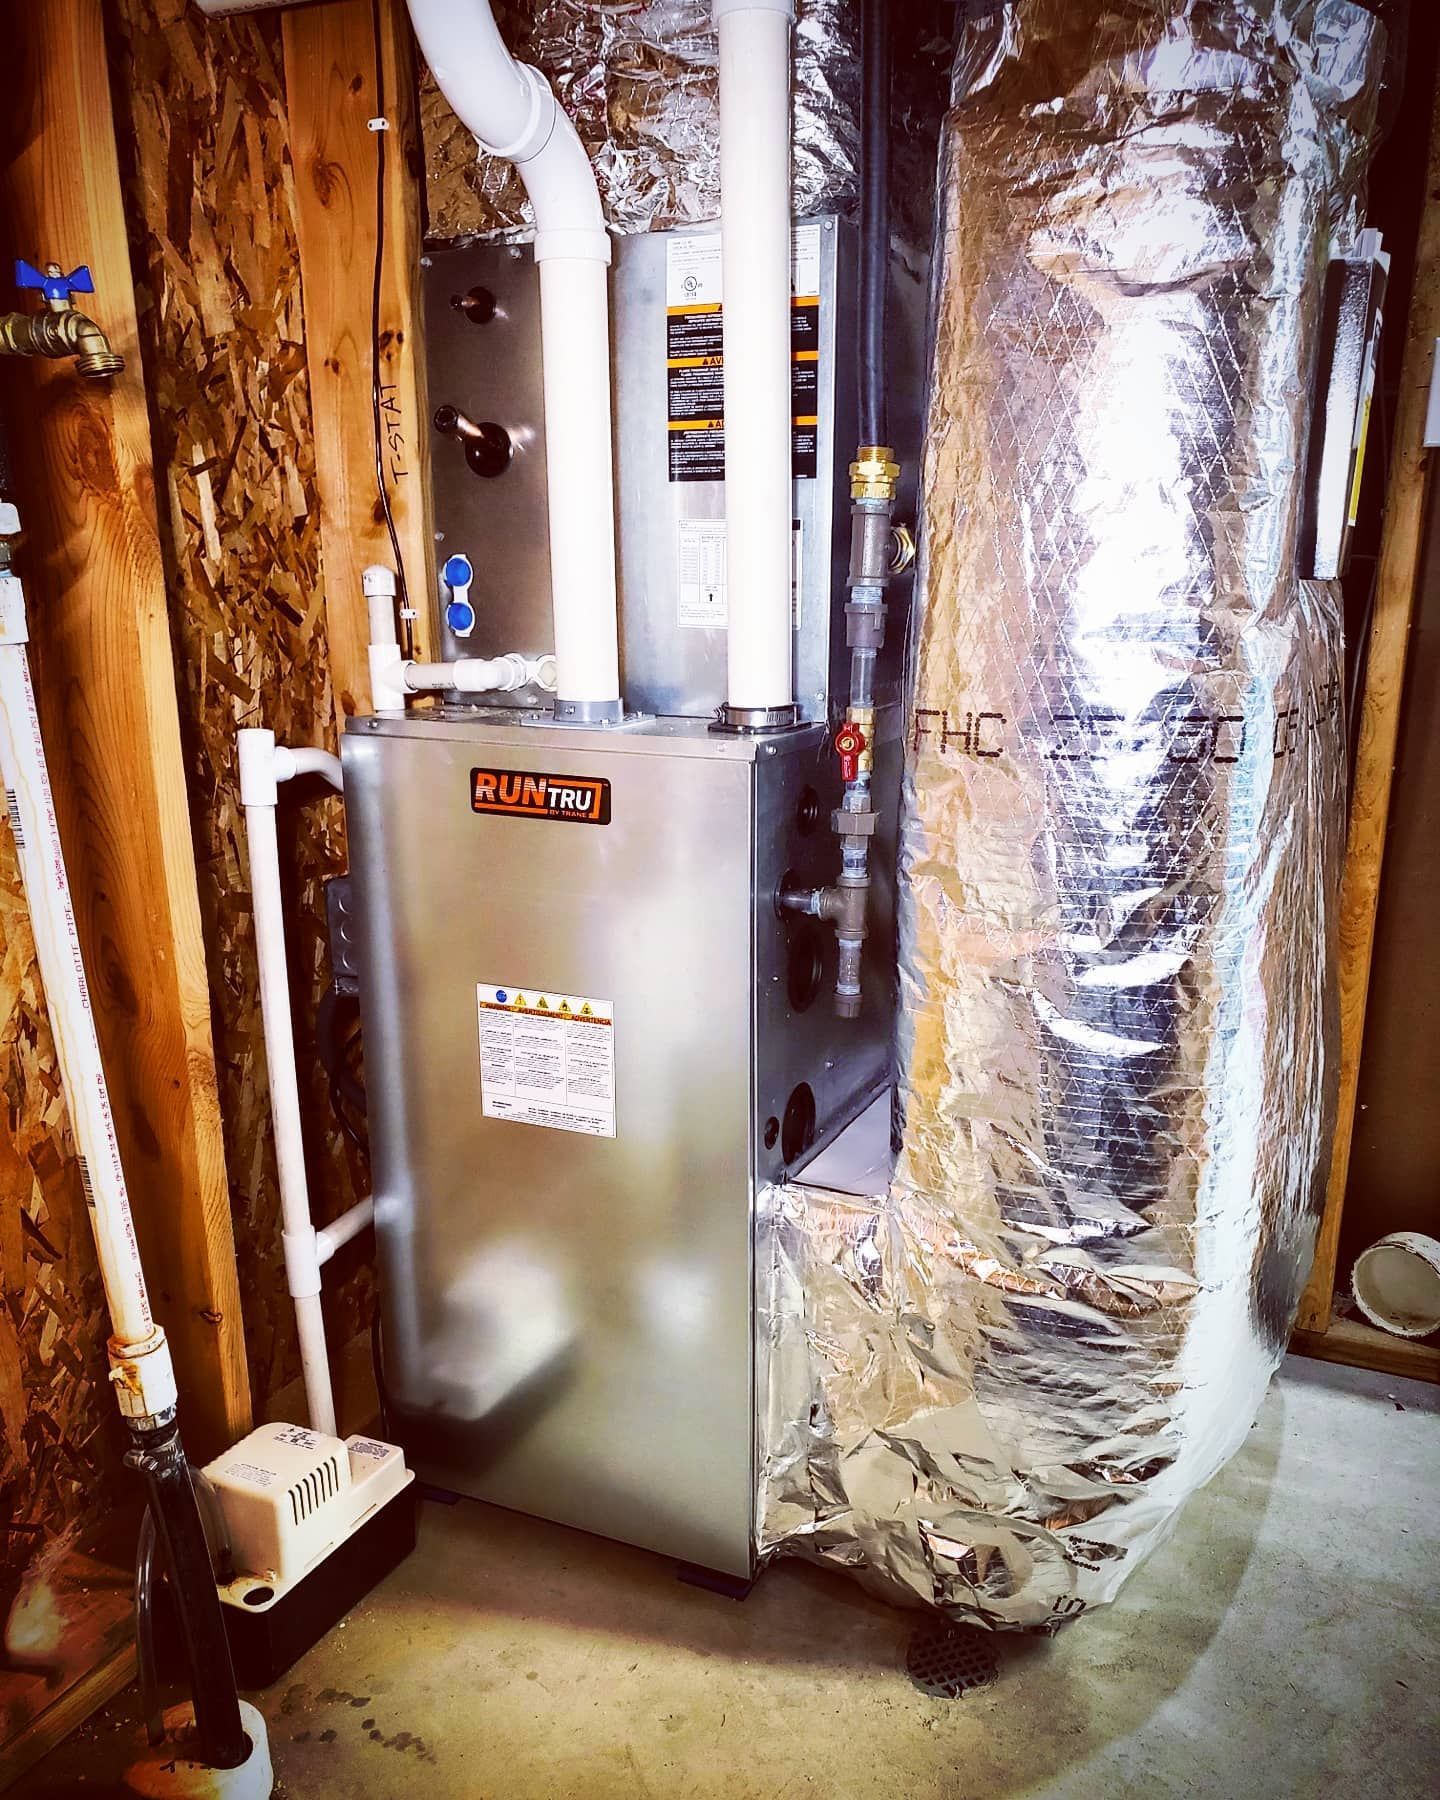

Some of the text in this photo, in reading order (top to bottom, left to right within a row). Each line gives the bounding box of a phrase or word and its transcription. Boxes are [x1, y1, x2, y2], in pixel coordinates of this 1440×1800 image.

[380, 384, 408, 485] T-STAT
[914, 709, 1007, 757] FHC
[571, 1014, 612, 1026] ADVERTENCIA
